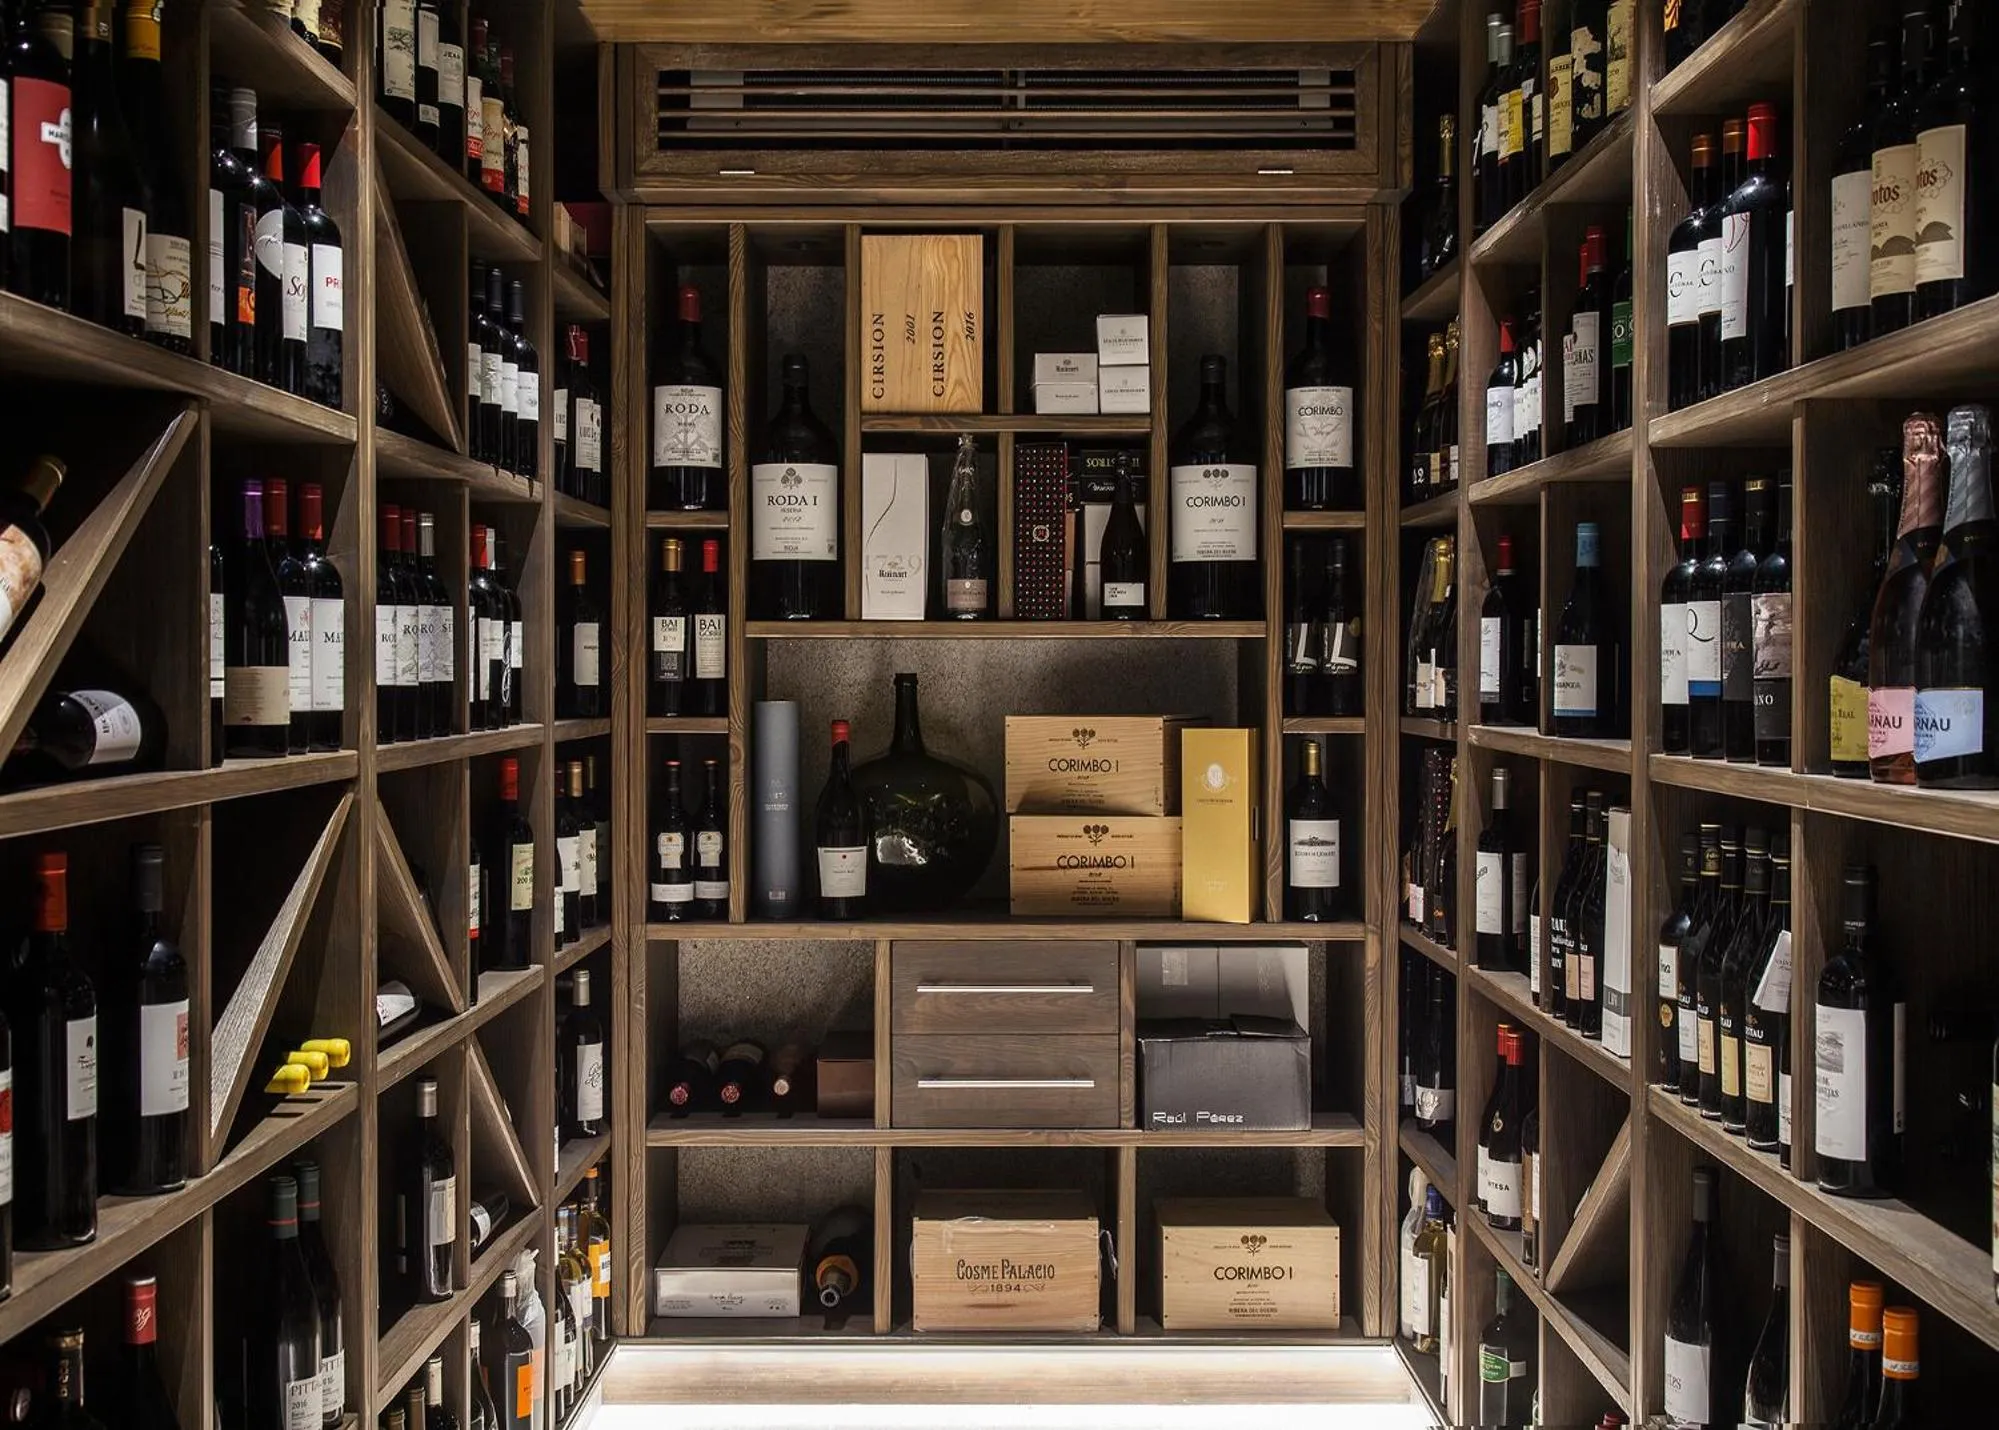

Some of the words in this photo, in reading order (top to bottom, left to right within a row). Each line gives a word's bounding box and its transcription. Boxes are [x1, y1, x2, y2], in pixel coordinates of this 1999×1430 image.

[906, 313, 916, 345] 2001
[965, 311, 976, 342] 2016
[872, 313, 885, 400] CIRSION
[932, 311, 945, 397] CIRSION
[664, 403, 710, 415] RODA
[1298, 406, 1344, 417] CORIMBO
[767, 495, 808, 506] RODA
[812, 495, 818, 506] I
[1185, 495, 1241, 508] CORIMBO
[1242, 496, 1246, 507] I
[661, 619, 678, 627] BAI
[699, 619, 721, 630] BAI
[1048, 758, 1112, 773] CORIMBO
[1115, 759, 1119, 773] I
[1056, 854, 1127, 870] CORIMBO
[1131, 855, 1135, 869] I
[1152, 1111, 1187, 1123] Raúl
[1196, 1111, 1244, 1123] Pérez
[956, 1258, 999, 1280] COSME
[1001, 1258, 1055, 1280] PALACIO
[1213, 1266, 1286, 1281] CORIMBO
[1289, 1266, 1293, 1280] I
[990, 1283, 1021, 1293] 1894
